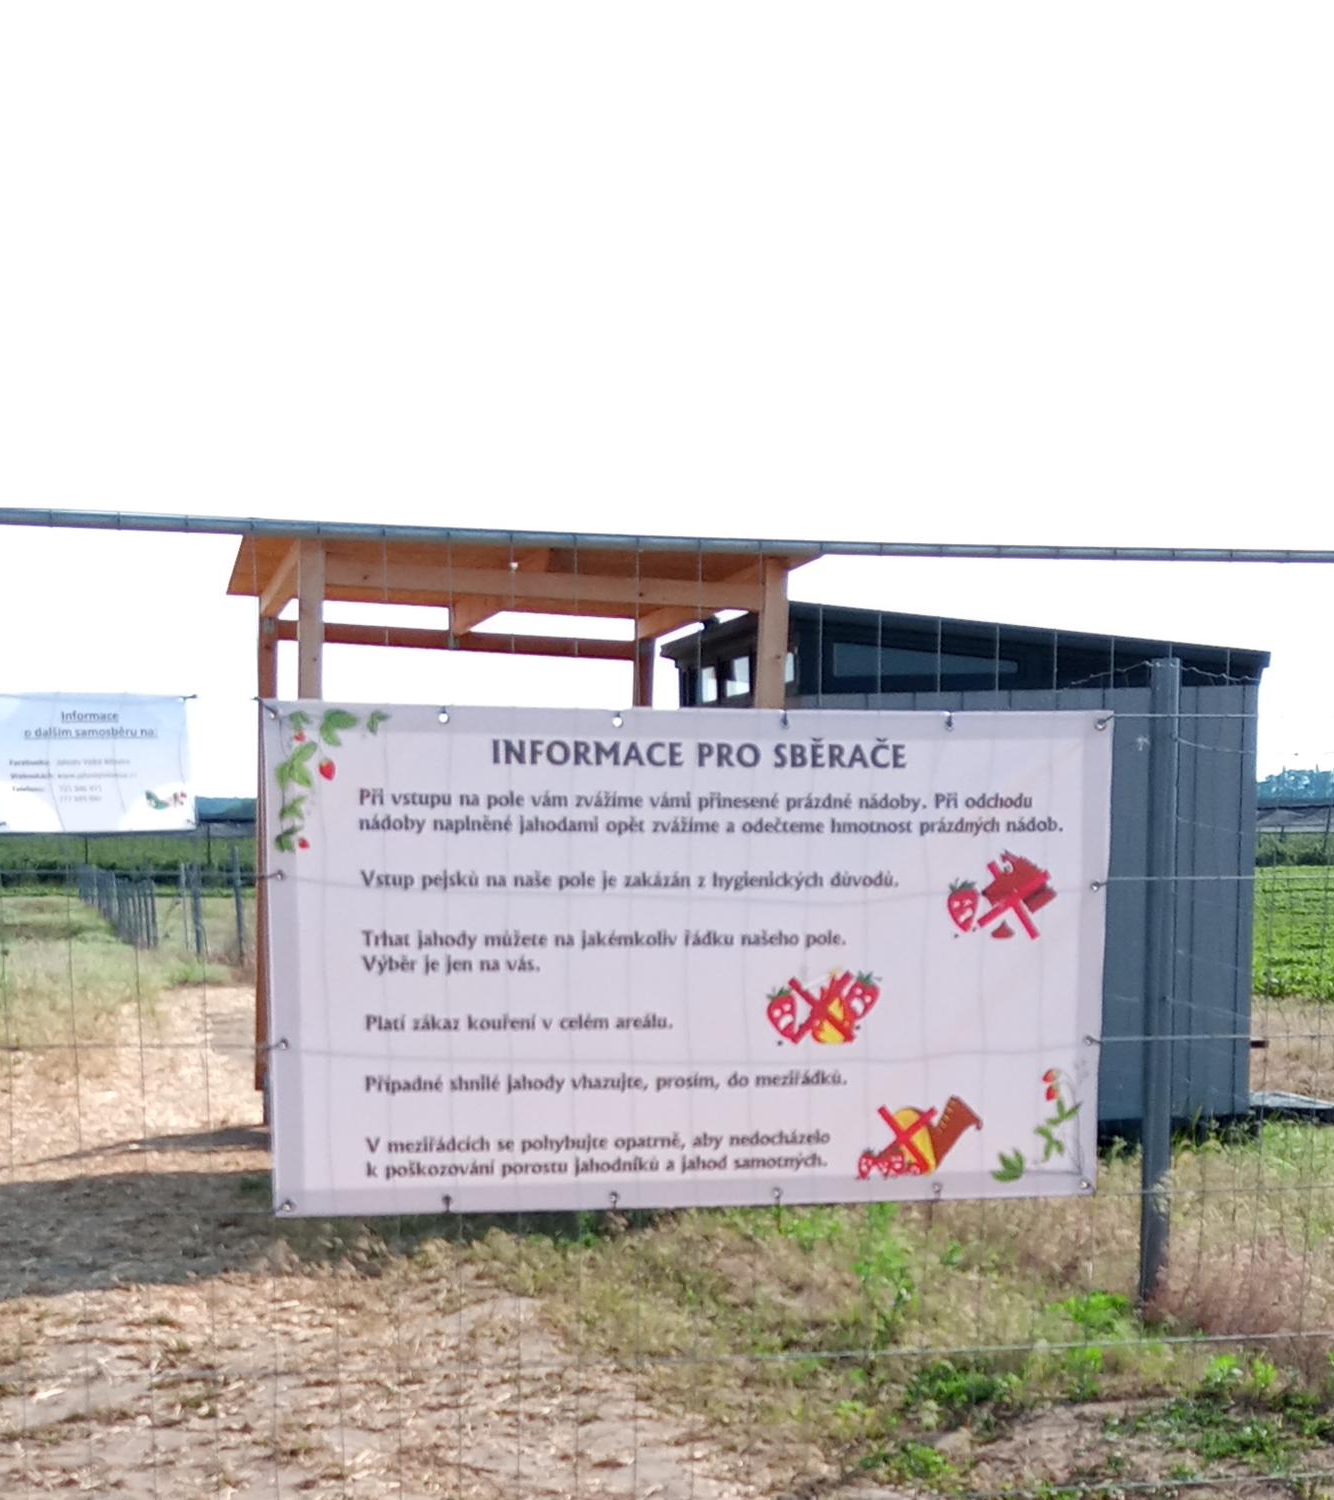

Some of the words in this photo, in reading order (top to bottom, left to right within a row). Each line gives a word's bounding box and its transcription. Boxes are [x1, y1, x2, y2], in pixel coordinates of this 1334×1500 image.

[61, 710, 119, 722] Informace
[75, 726, 137, 738] samosběru
[492, 738, 684, 768] INFORMACE
[696, 742, 762, 769] PRO
[773, 737, 907, 769] SBĚRAČE
[359, 787, 385, 806] Při
[391, 792, 452, 809] vstupu
[459, 793, 480, 807] na
[486, 790, 525, 811] pole
[530, 791, 569, 808] vám
[574, 791, 644, 809] zvážíme
[649, 791, 692, 809] vámi
[697, 791, 780, 813] přinesené
[785, 792, 852, 813] prázdné
[858, 793, 927, 813] nádoby.
[934, 792, 959, 809] Při
[964, 792, 1033, 809] odchodu
[358, 814, 426, 835] nádoby
[432, 814, 513, 835] naplněné
[519, 815, 599, 836] jahodami
[605, 815, 645, 836] opět
[651, 816, 720, 834] zvážíme
[725, 821, 736, 834] a
[741, 817, 825, 834] odečteme
[830, 817, 913, 834] hmotnost
[919, 816, 1000, 837] prázdných
[1005, 816, 1064, 833] nádob.
[360, 869, 415, 891] Vstup
[421, 869, 479, 892] pejsků
[485, 875, 507, 888] na
[513, 870, 552, 888] naše
[557, 871, 596, 891] pole
[602, 870, 617, 891] je
[624, 871, 691, 888] zakázán
[697, 875, 706, 888] z
[712, 870, 824, 892] hygienických
[829, 871, 899, 888] důvodů.
[361, 929, 410, 948] Trhat
[417, 930, 478, 951] jahody
[484, 930, 548, 948] můžete
[554, 934, 575, 947] na
[581, 930, 677, 950] jakémkoliv
[683, 929, 735, 947] řádku
[740, 930, 800, 947] našeho
[804, 929, 846, 949] pole.
[361, 954, 416, 976] Výběr
[424, 954, 440, 976] je
[445, 954, 473, 975] jen
[479, 959, 501, 972] na
[505, 957, 540, 972] vás.
[365, 1014, 406, 1032] Platí
[412, 1015, 460, 1032] zákaz
[467, 1014, 536, 1031] kouření
[542, 1018, 552, 1030] v
[558, 1013, 610, 1030] celém
[615, 1013, 673, 1030] areálu.
[364, 1075, 444, 1096] Případné
[449, 1074, 501, 1092] shnilé
[506, 1074, 565, 1095] jahody
[570, 1072, 648, 1093] vhazujte,
[655, 1074, 720, 1092] prosím,
[726, 1071, 750, 1088] do
[754, 1069, 847, 1088] meziřádků.
[365, 1137, 381, 1154] V
[387, 1135, 491, 1154] meziřádcích
[497, 1139, 515, 1152] se
[520, 1133, 608, 1155] pohybujte
[613, 1132, 686, 1152] opatrně,
[691, 1132, 724, 1151] aby
[728, 1129, 831, 1147] nedocházelo
[366, 1161, 378, 1178] k
[384, 1160, 495, 1181] poškozování
[501, 1161, 568, 1178] porostu
[574, 1155, 660, 1177] jahodníků
[665, 1159, 675, 1172] a
[680, 1155, 728, 1174] jahod
[733, 1152, 828, 1171] samotných.
